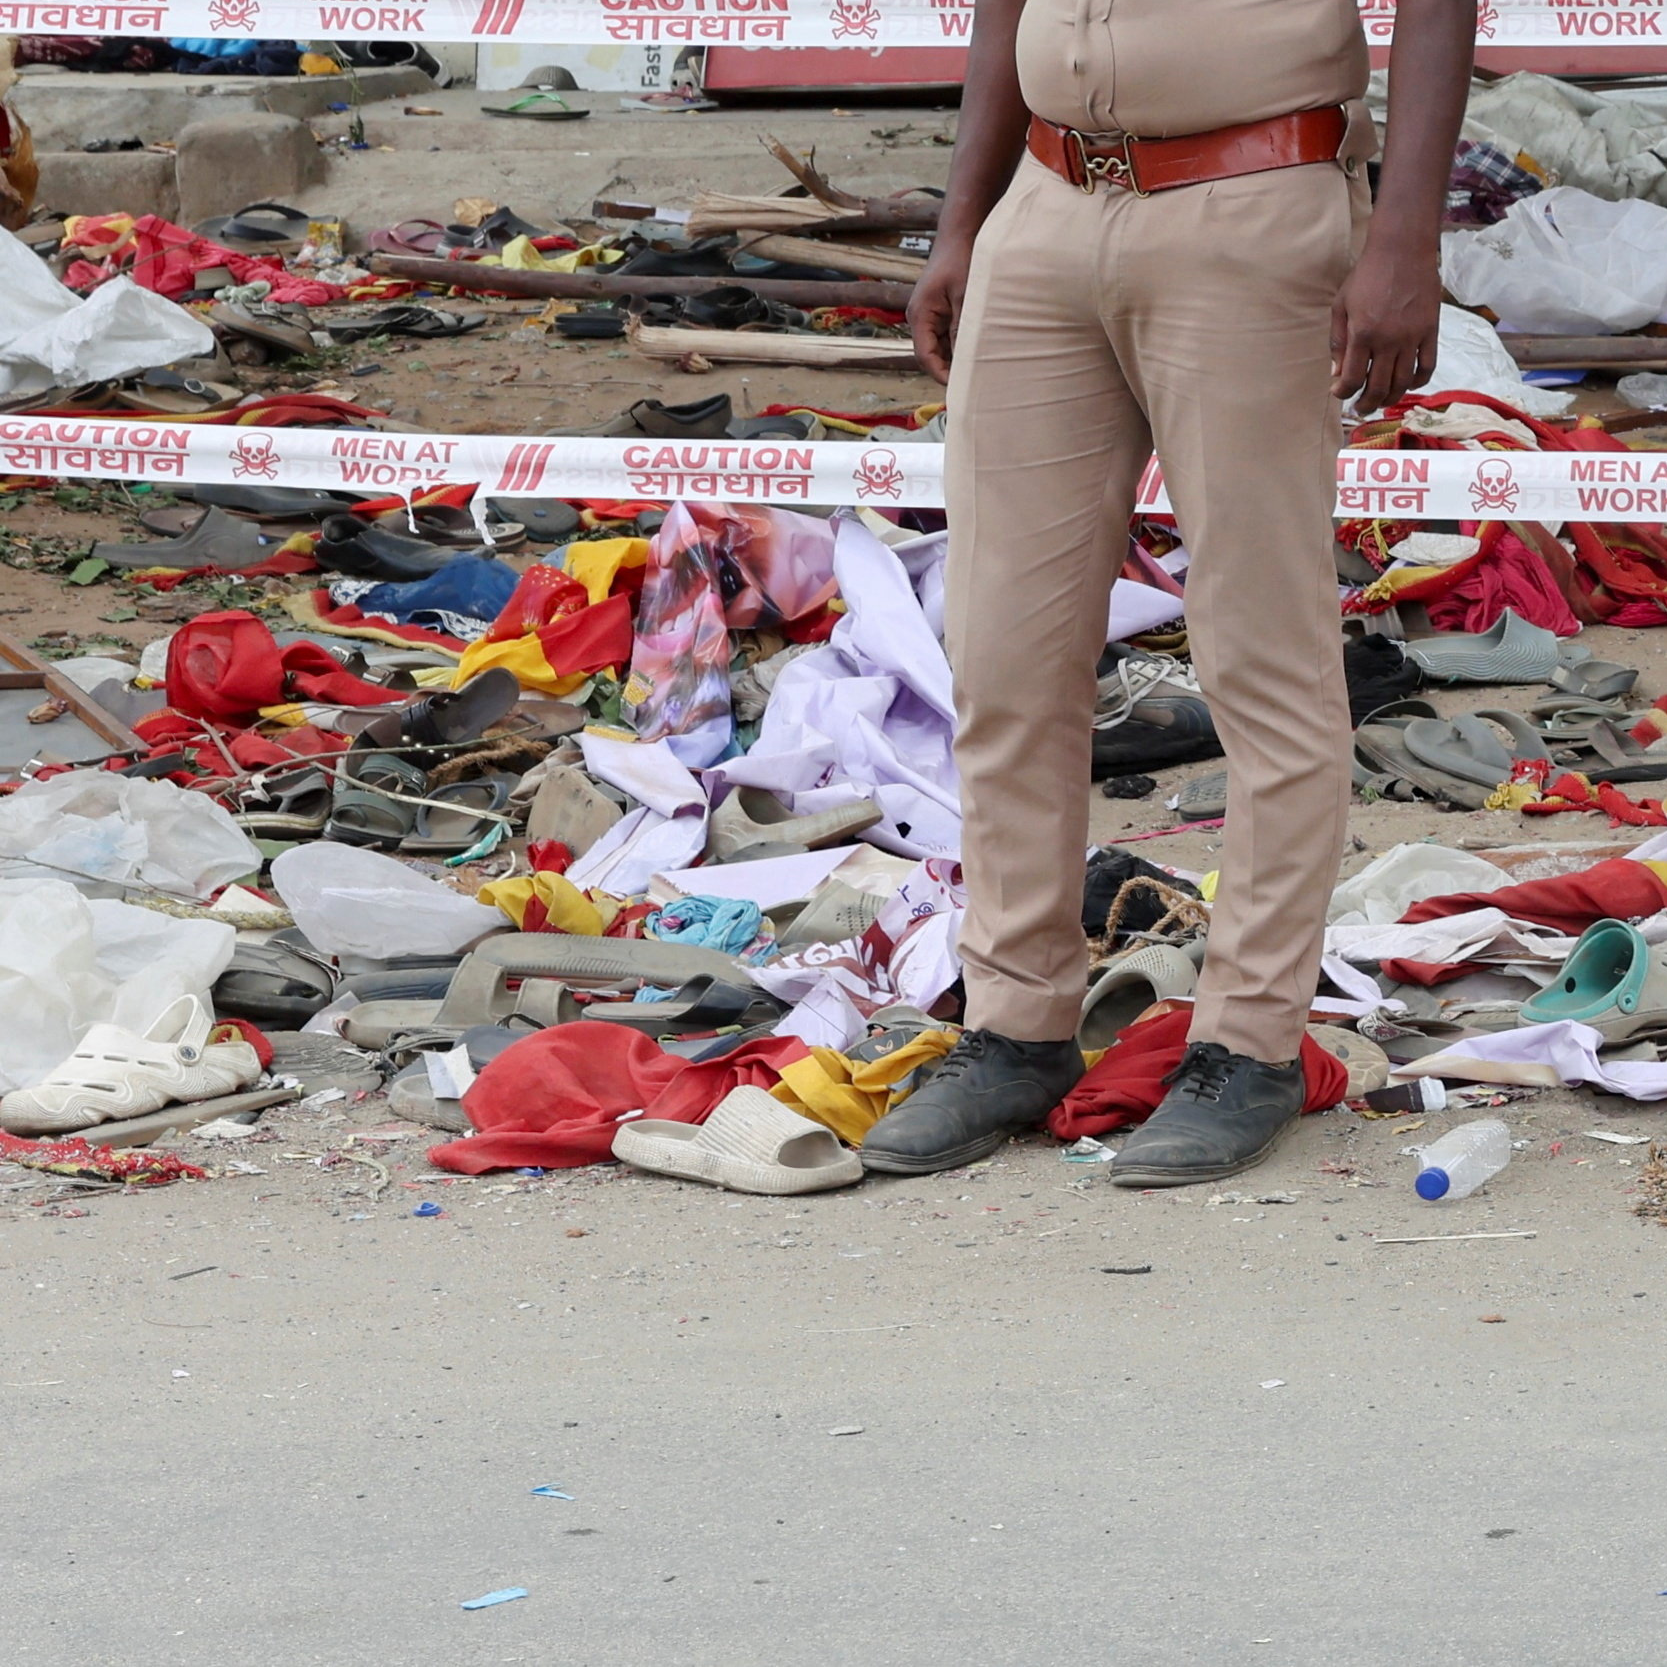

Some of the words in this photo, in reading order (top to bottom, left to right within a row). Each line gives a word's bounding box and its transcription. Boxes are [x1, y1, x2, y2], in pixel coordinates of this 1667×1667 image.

[319, 7, 425, 32] WORK
[603, 15, 791, 41] सावधान
[1557, 12, 1661, 36] WORK
[0, 421, 191, 449] CAUTION
[1, 444, 190, 477] सावधान
[332, 436, 403, 462] MEN
[415, 441, 459, 464] AT
[622, 446, 813, 470] CAUTION
[626, 471, 815, 498] सावधान
[1570, 460, 1641, 483] MEN
